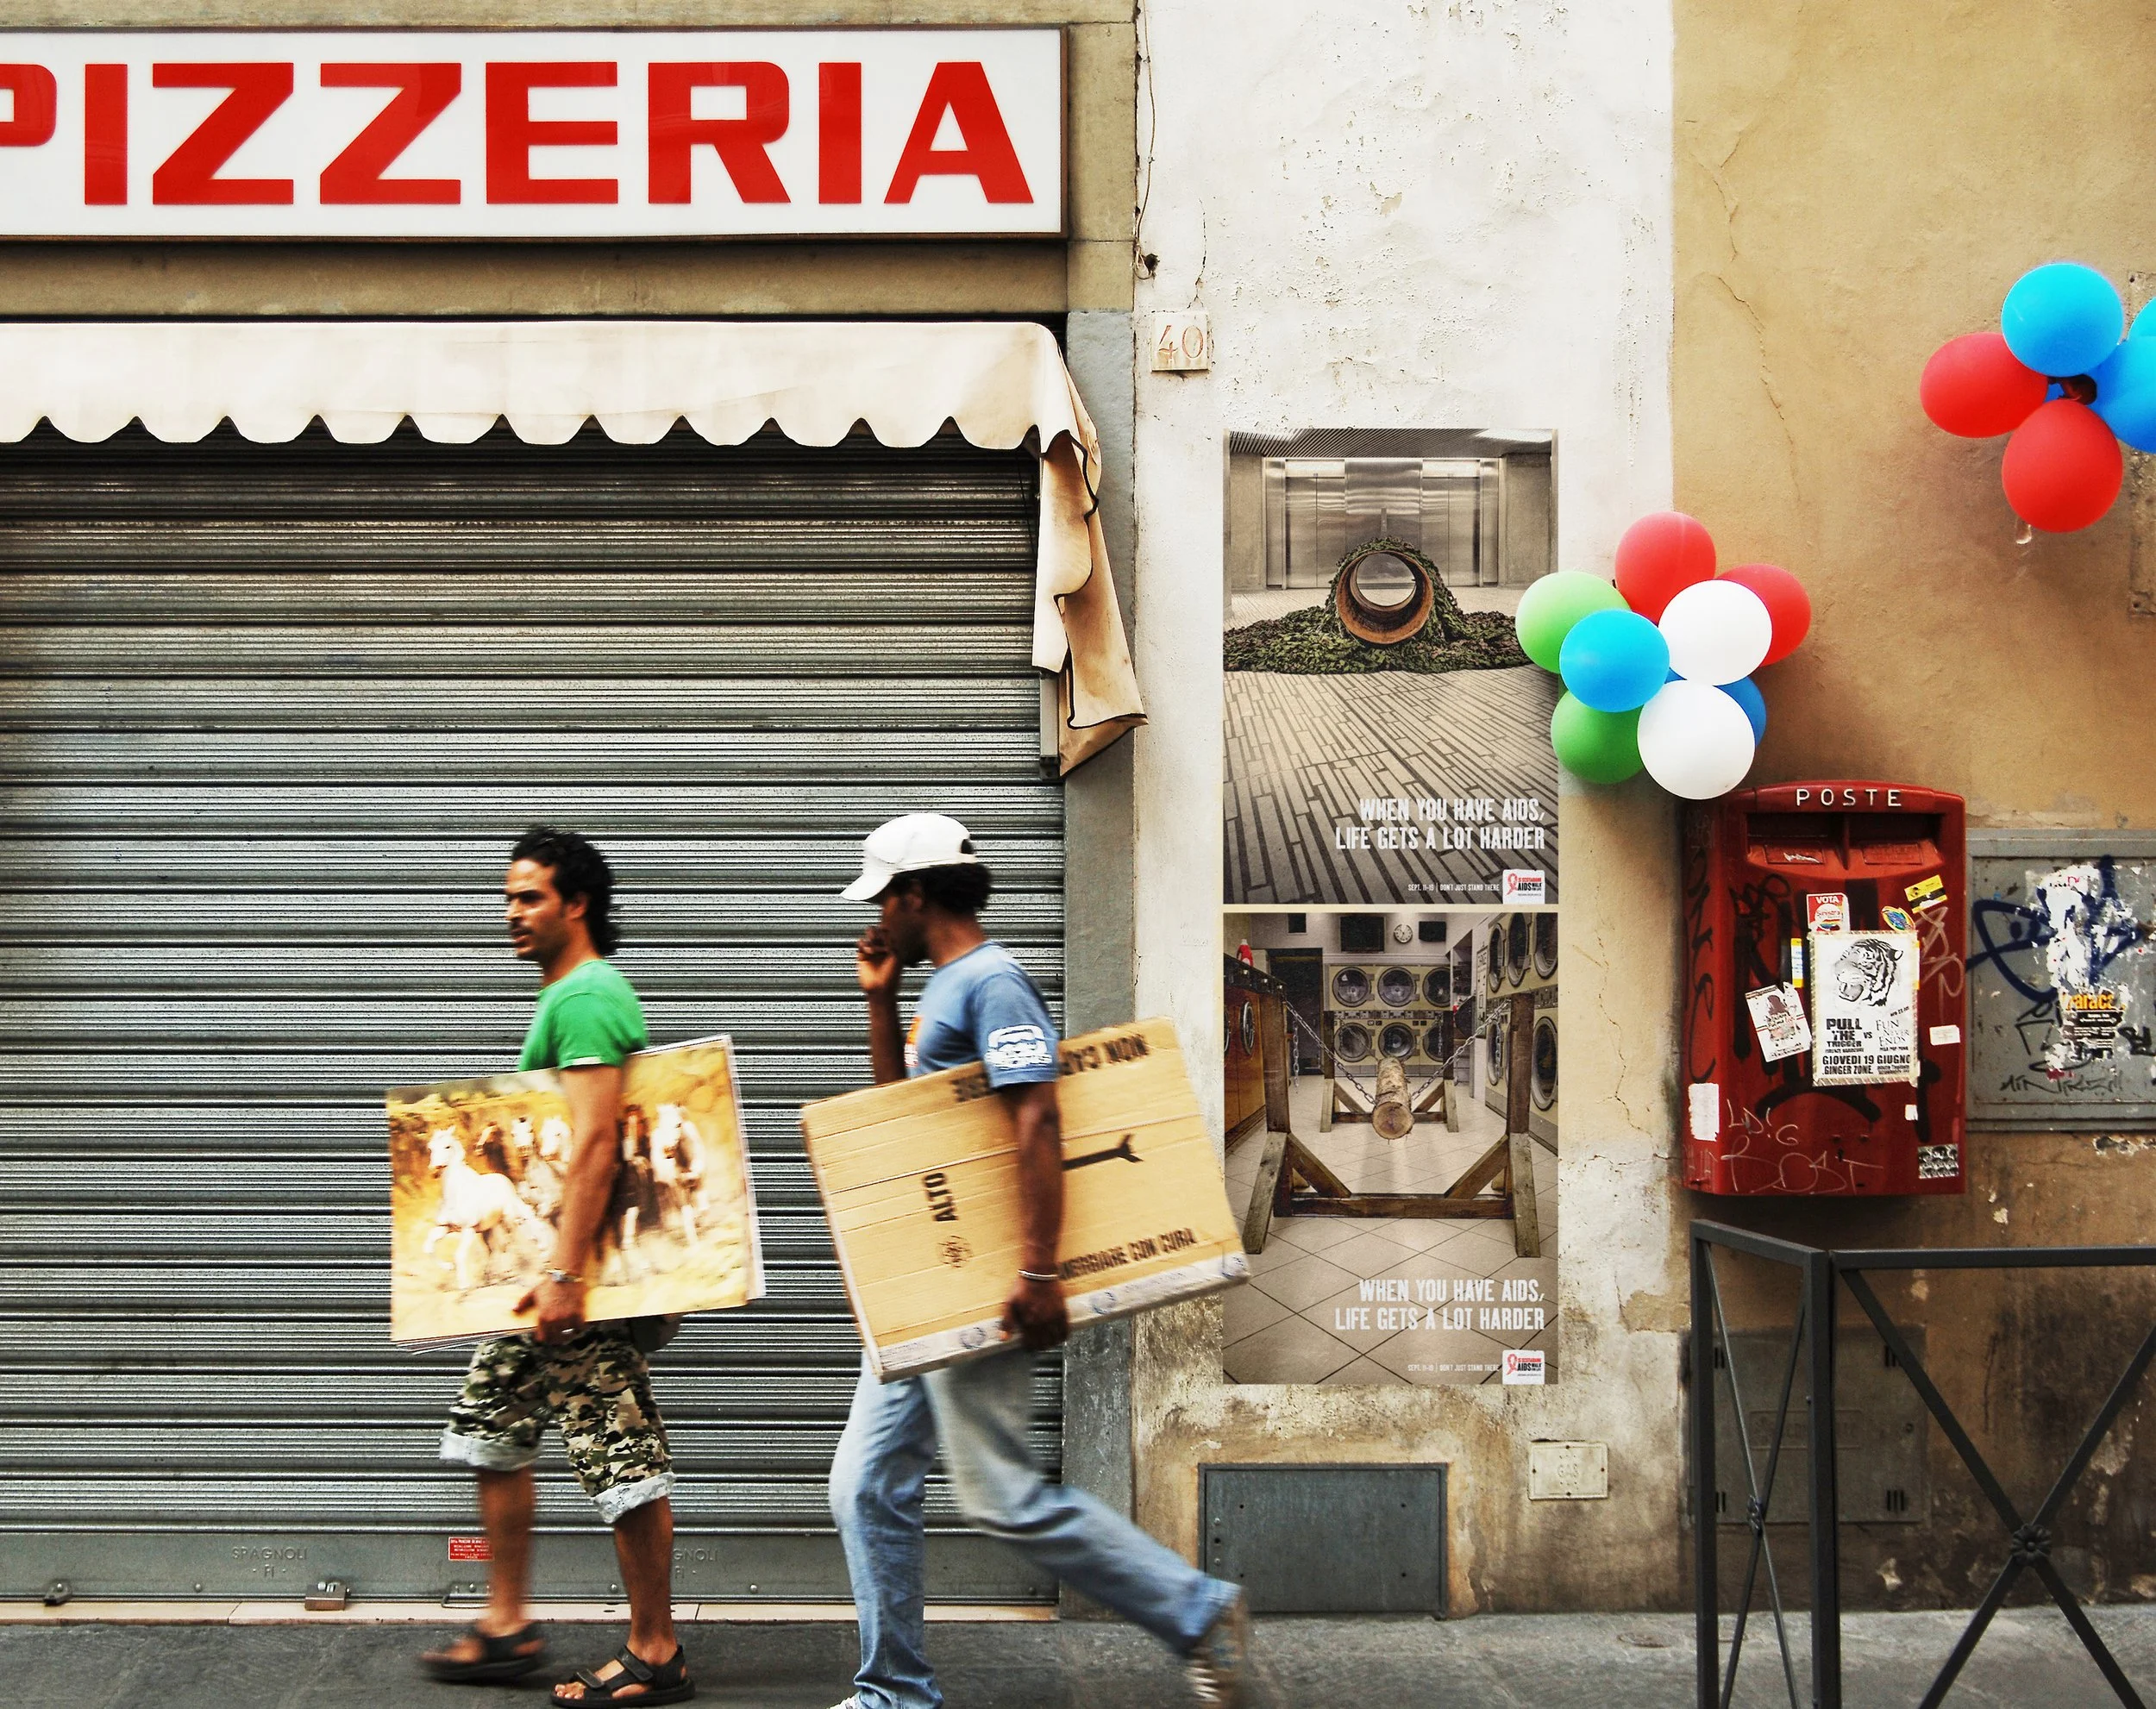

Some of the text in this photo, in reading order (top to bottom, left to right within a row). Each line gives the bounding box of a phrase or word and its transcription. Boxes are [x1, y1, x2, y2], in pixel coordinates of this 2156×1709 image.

[1157, 324, 1204, 359] 40
[1796, 788, 1902, 807] POSTE
[1359, 798, 1545, 822] WHEN YOU HAVE AIDS,
[1335, 827, 1545, 849] LIFE GETS A LOT HARDER
[1518, 882, 1532, 891] AIDS
[1815, 895, 1839, 904] VOTA
[1826, 1018, 1862, 1030] PULL
[1876, 1019, 1899, 1030] FUN
[1831, 1030, 1855, 1040] THE
[1103, 1033, 1149, 1064] NON
[1822, 1055, 1861, 1065] GIOVEDI
[1864, 1055, 1874, 1065] 19
[924, 1172, 959, 1221] ALTO
[1128, 1238, 1160, 1261] CON
[1158, 1228, 1197, 1253] CURA
[1359, 1279, 1545, 1302] WHEN YOU HAVE AIDS,
[1335, 1307, 1545, 1330] LIFE GETS A LOT HARDER
[231, 1546, 308, 1560] SPAGNOLI
[673, 1548, 718, 1562] GNOLI
